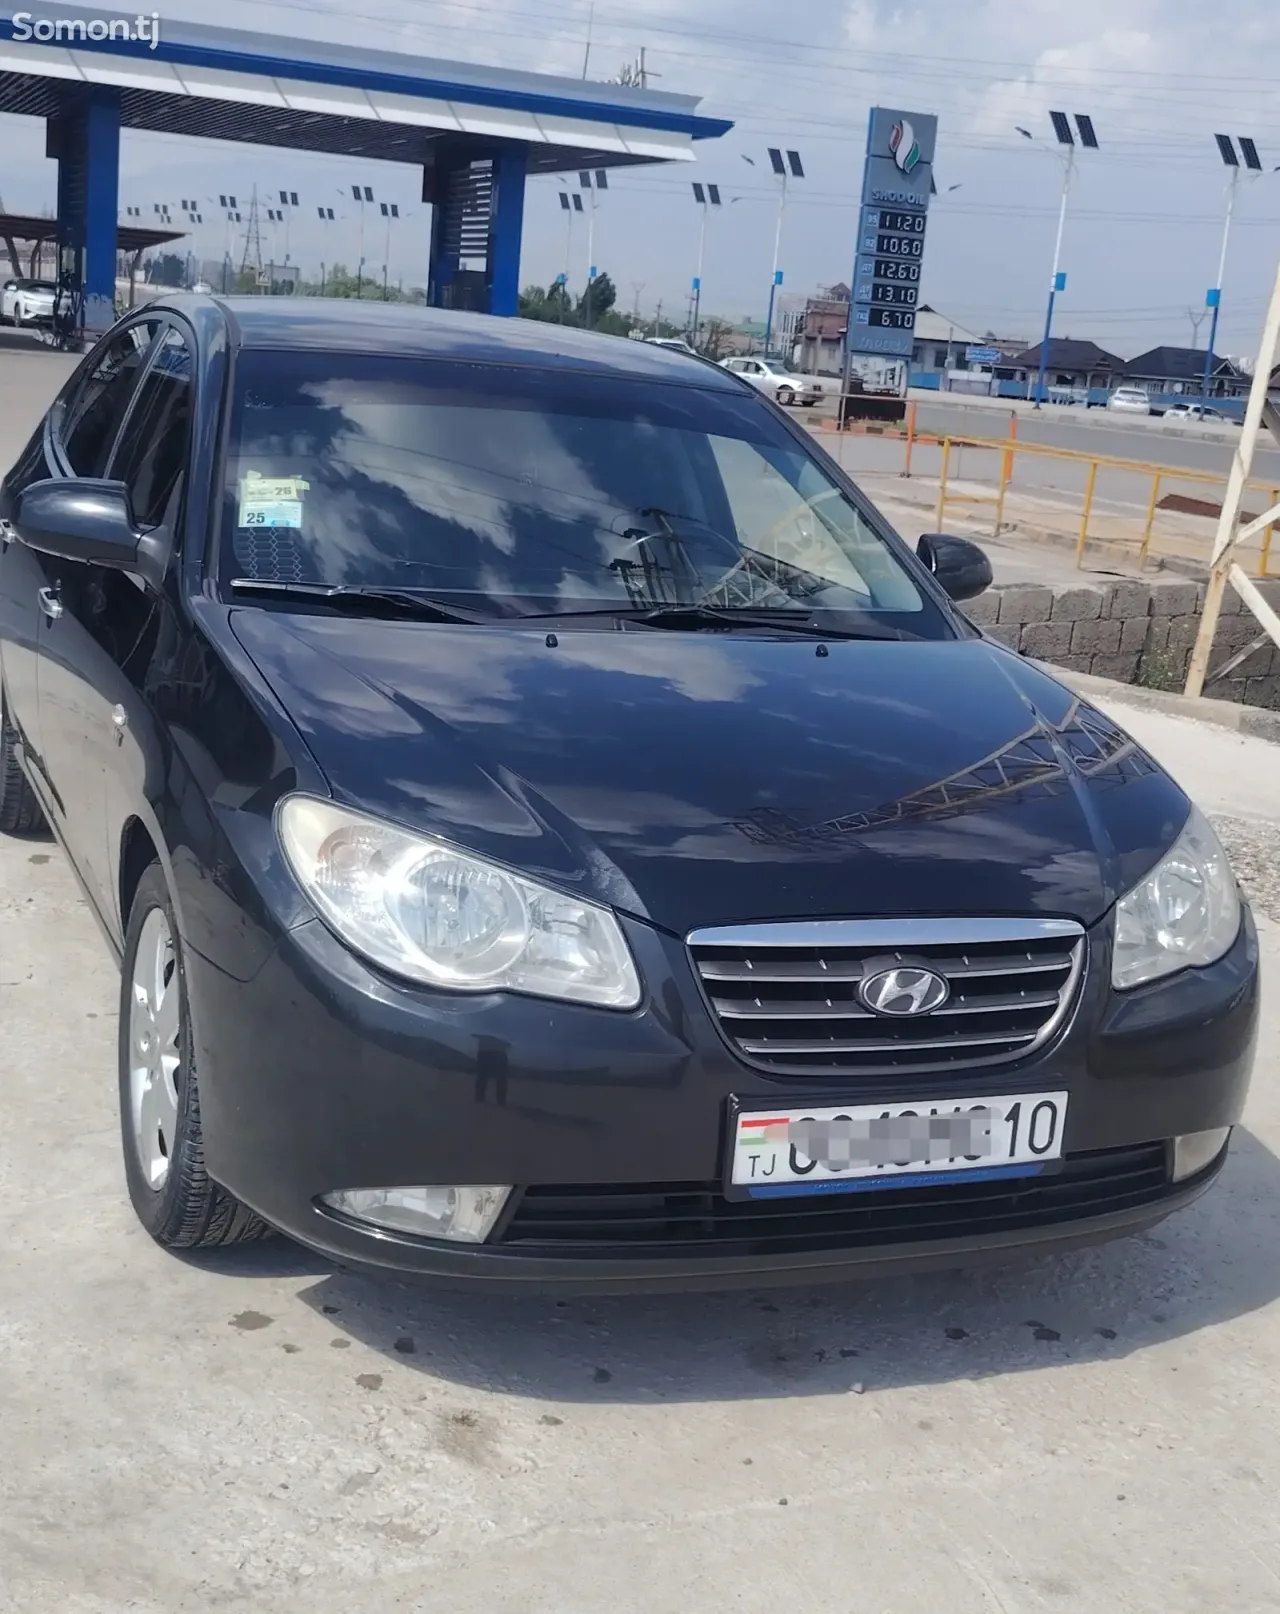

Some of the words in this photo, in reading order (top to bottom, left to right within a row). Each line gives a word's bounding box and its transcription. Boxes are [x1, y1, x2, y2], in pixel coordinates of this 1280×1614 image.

[886, 215, 924, 232] 11.20
[883, 238, 921, 255] 10.60
[880, 263, 919, 280] 12.60
[878, 287, 916, 303] 13.10
[881, 312, 913, 328] 6.70
[246, 512, 266, 524] 25
[1004, 1100, 1058, 1157] 10
[748, 1153, 776, 1177] TJ
